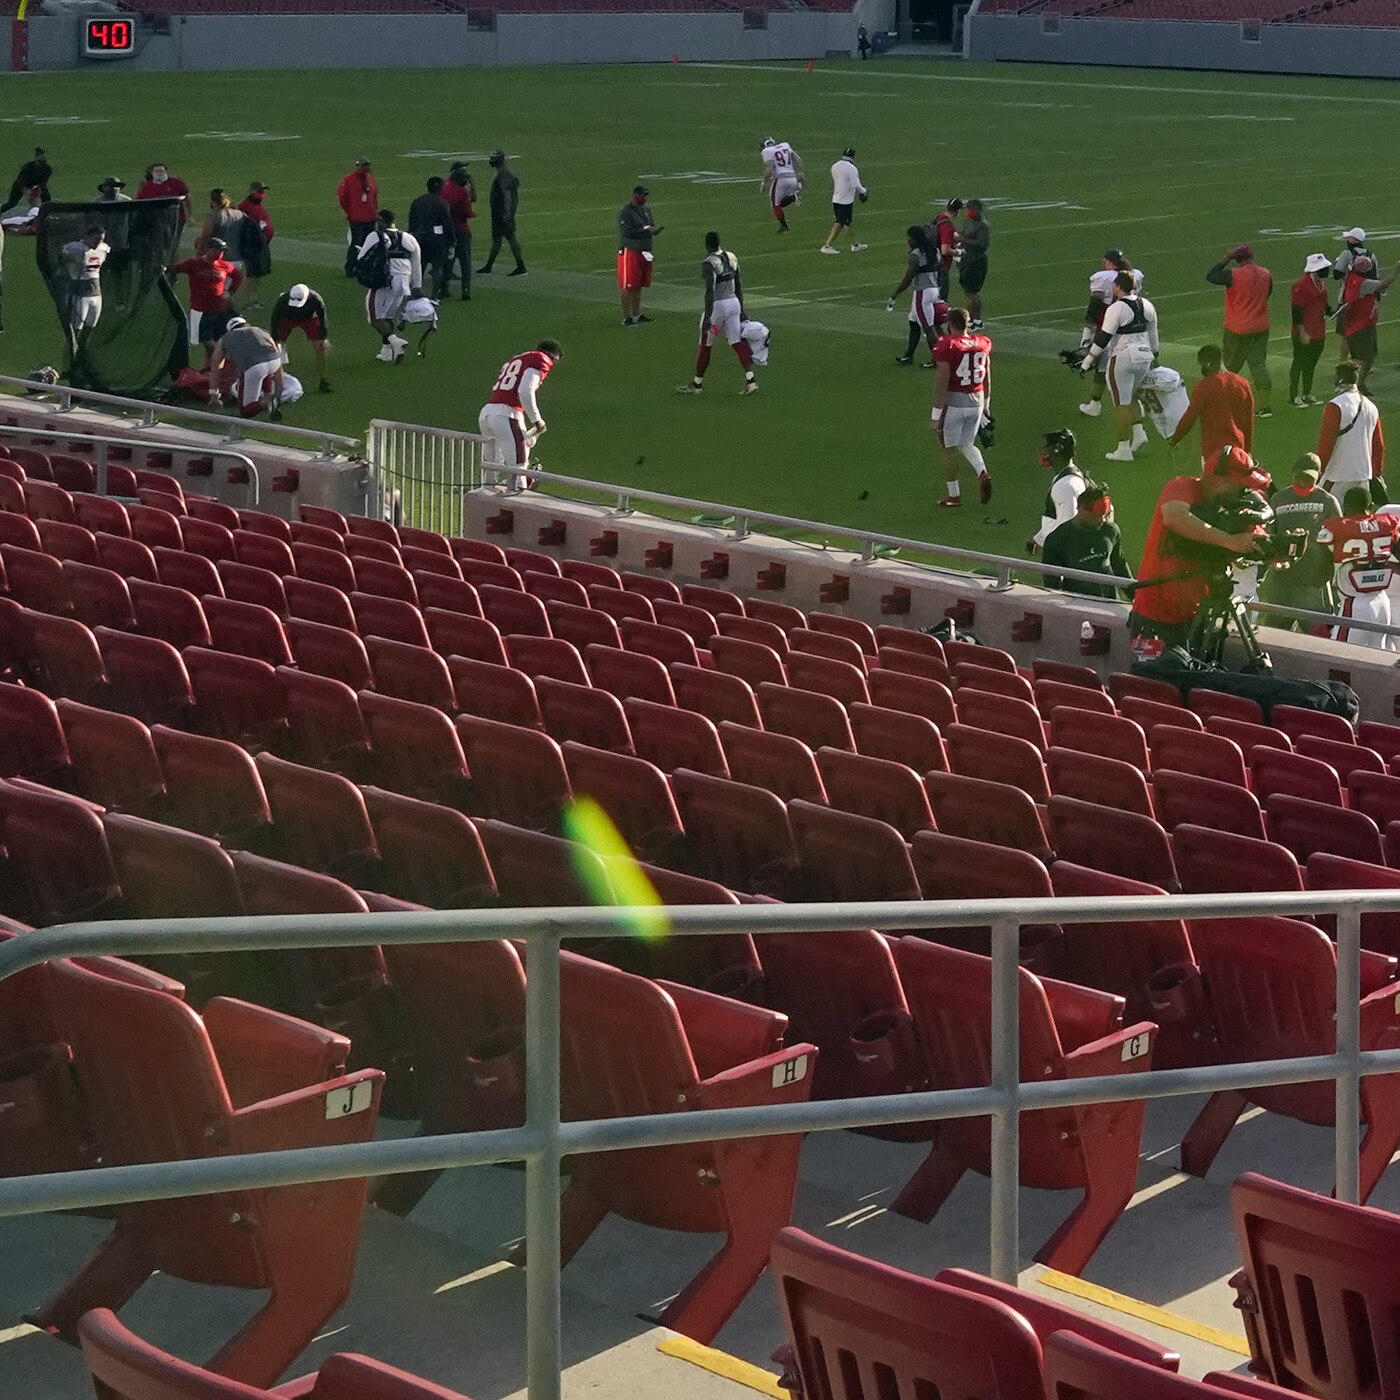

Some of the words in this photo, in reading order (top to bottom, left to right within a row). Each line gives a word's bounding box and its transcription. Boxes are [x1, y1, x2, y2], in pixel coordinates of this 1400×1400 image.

[89, 21, 128, 49] 40
[956, 351, 987, 386] 48
[1130, 1036, 1140, 1057] G
[782, 1058, 798, 1084] H
[342, 1084, 357, 1113] J
